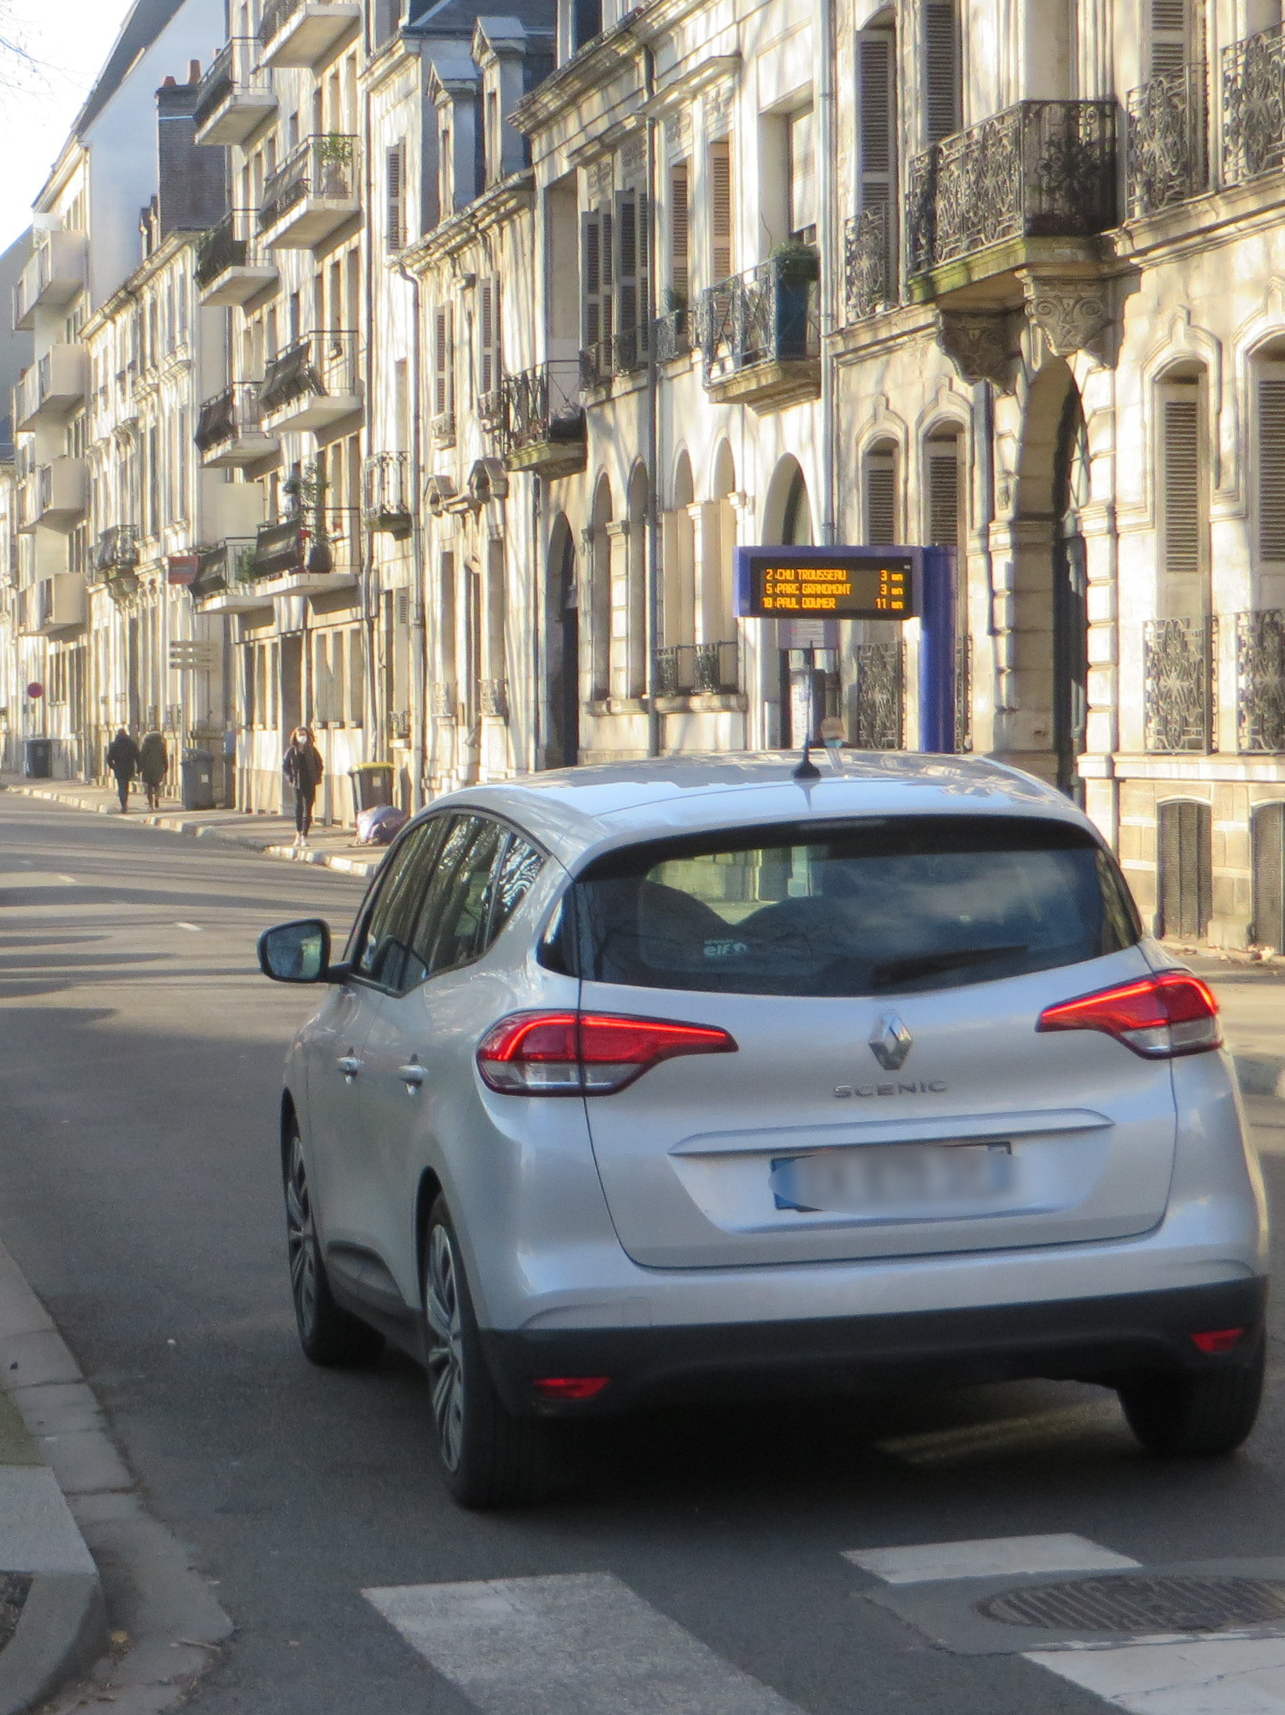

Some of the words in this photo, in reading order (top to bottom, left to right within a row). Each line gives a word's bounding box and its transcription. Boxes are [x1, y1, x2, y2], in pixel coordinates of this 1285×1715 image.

[765, 569, 773, 581] 2
[797, 569, 847, 581] TROUSSEAU
[880, 570, 888, 581] 3
[765, 583, 773, 594] 5
[801, 583, 852, 595] GRANDMONT
[880, 584, 888, 595] 3
[801, 597, 836, 609] DOUMER
[875, 598, 887, 609] 11
[834, 1080, 948, 1099] SCENIC
